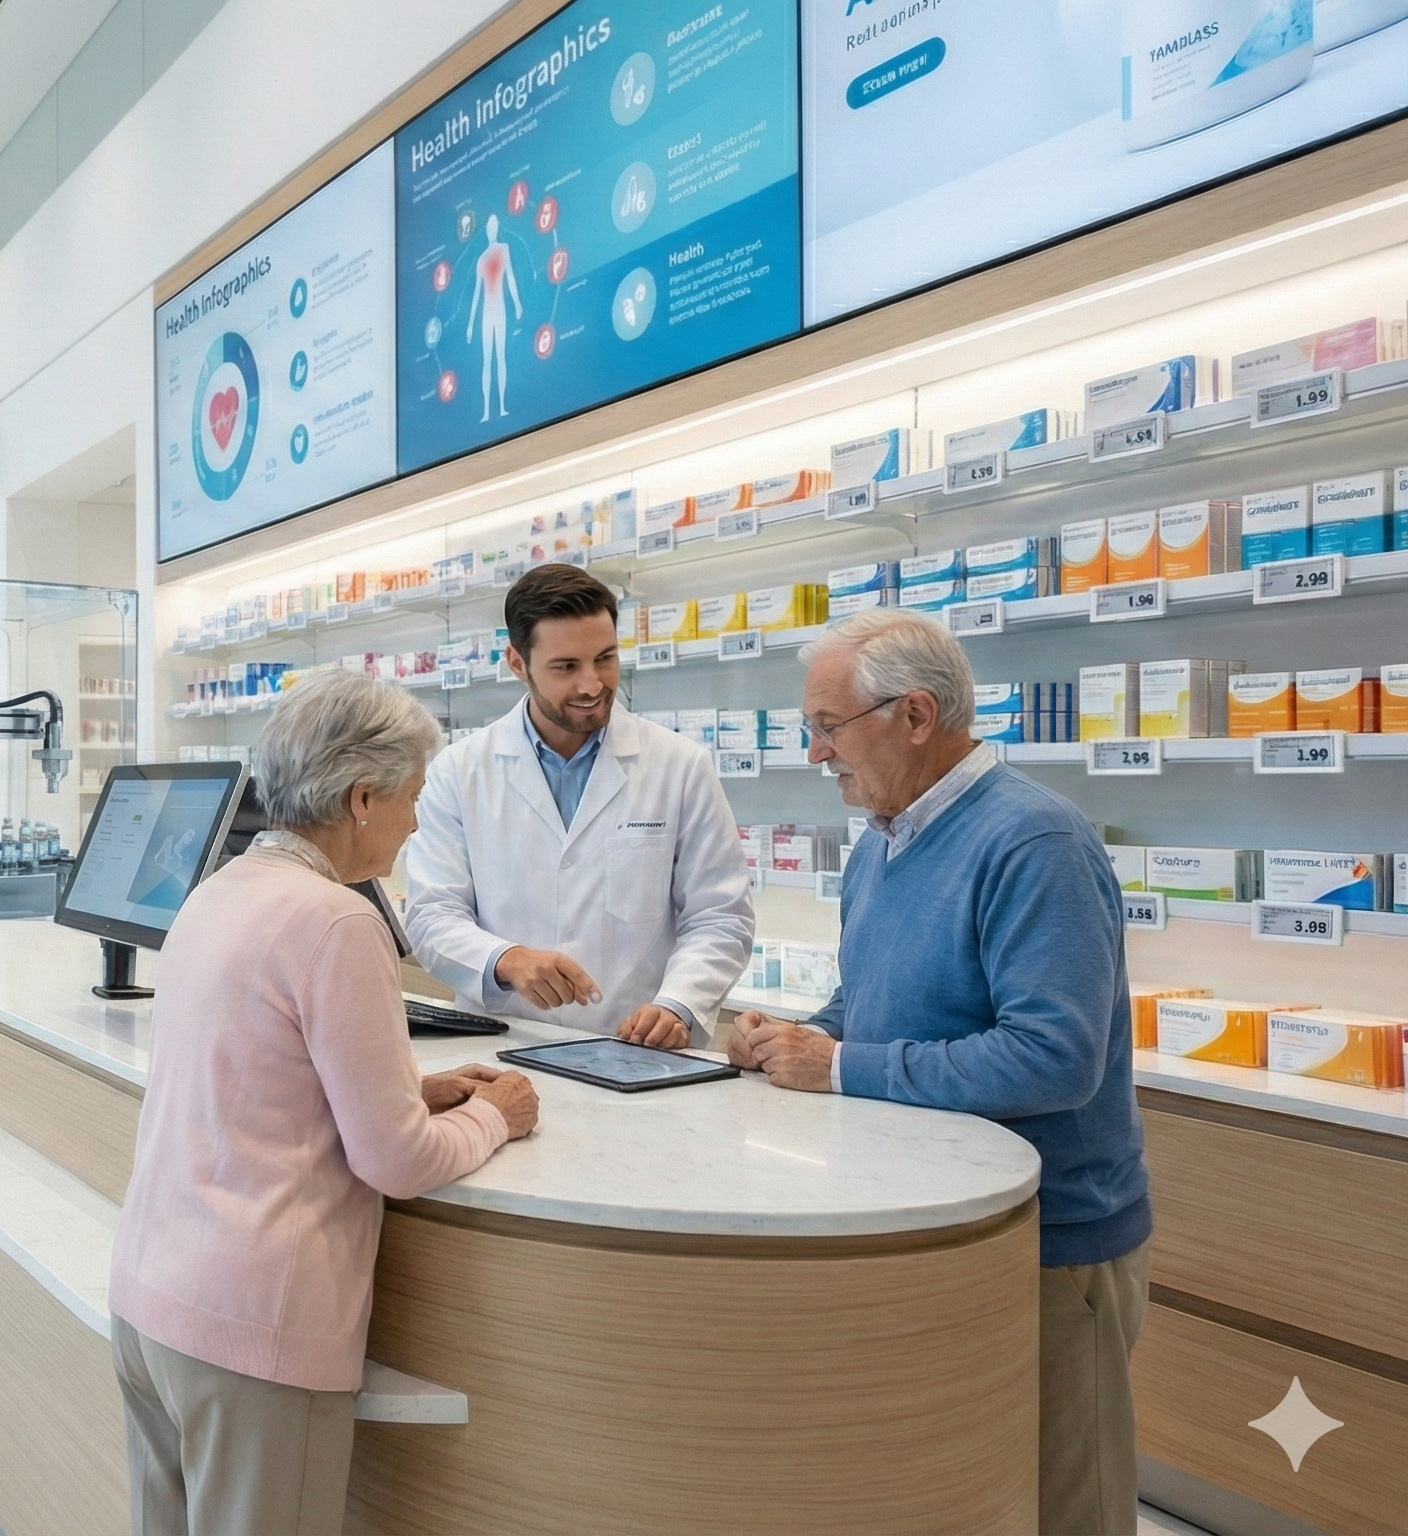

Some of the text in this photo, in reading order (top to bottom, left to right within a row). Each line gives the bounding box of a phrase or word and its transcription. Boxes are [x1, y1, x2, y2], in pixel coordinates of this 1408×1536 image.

[411, 110, 470, 173] Health
[166, 299, 200, 339] Health
[1296, 389, 1329, 408] 1.99
[1297, 747, 1329, 762] 1.99
